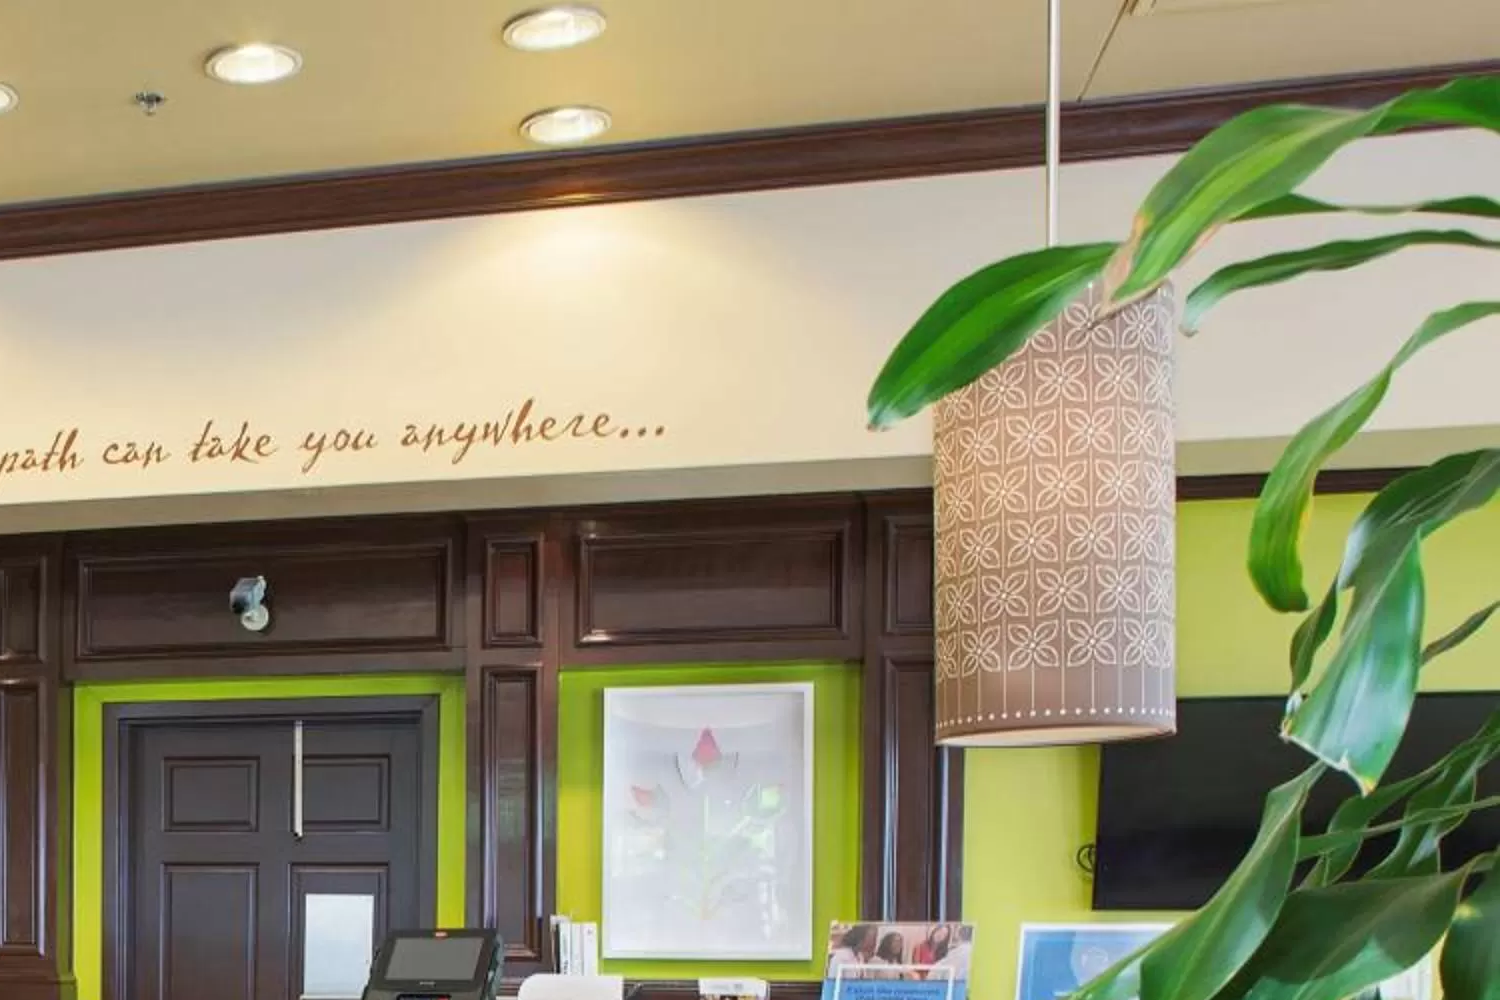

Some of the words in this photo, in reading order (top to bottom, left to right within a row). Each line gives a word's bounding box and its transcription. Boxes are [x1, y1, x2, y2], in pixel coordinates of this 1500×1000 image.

[101, 437, 172, 469] can
[188, 419, 279, 465] take
[299, 428, 379, 474] you
